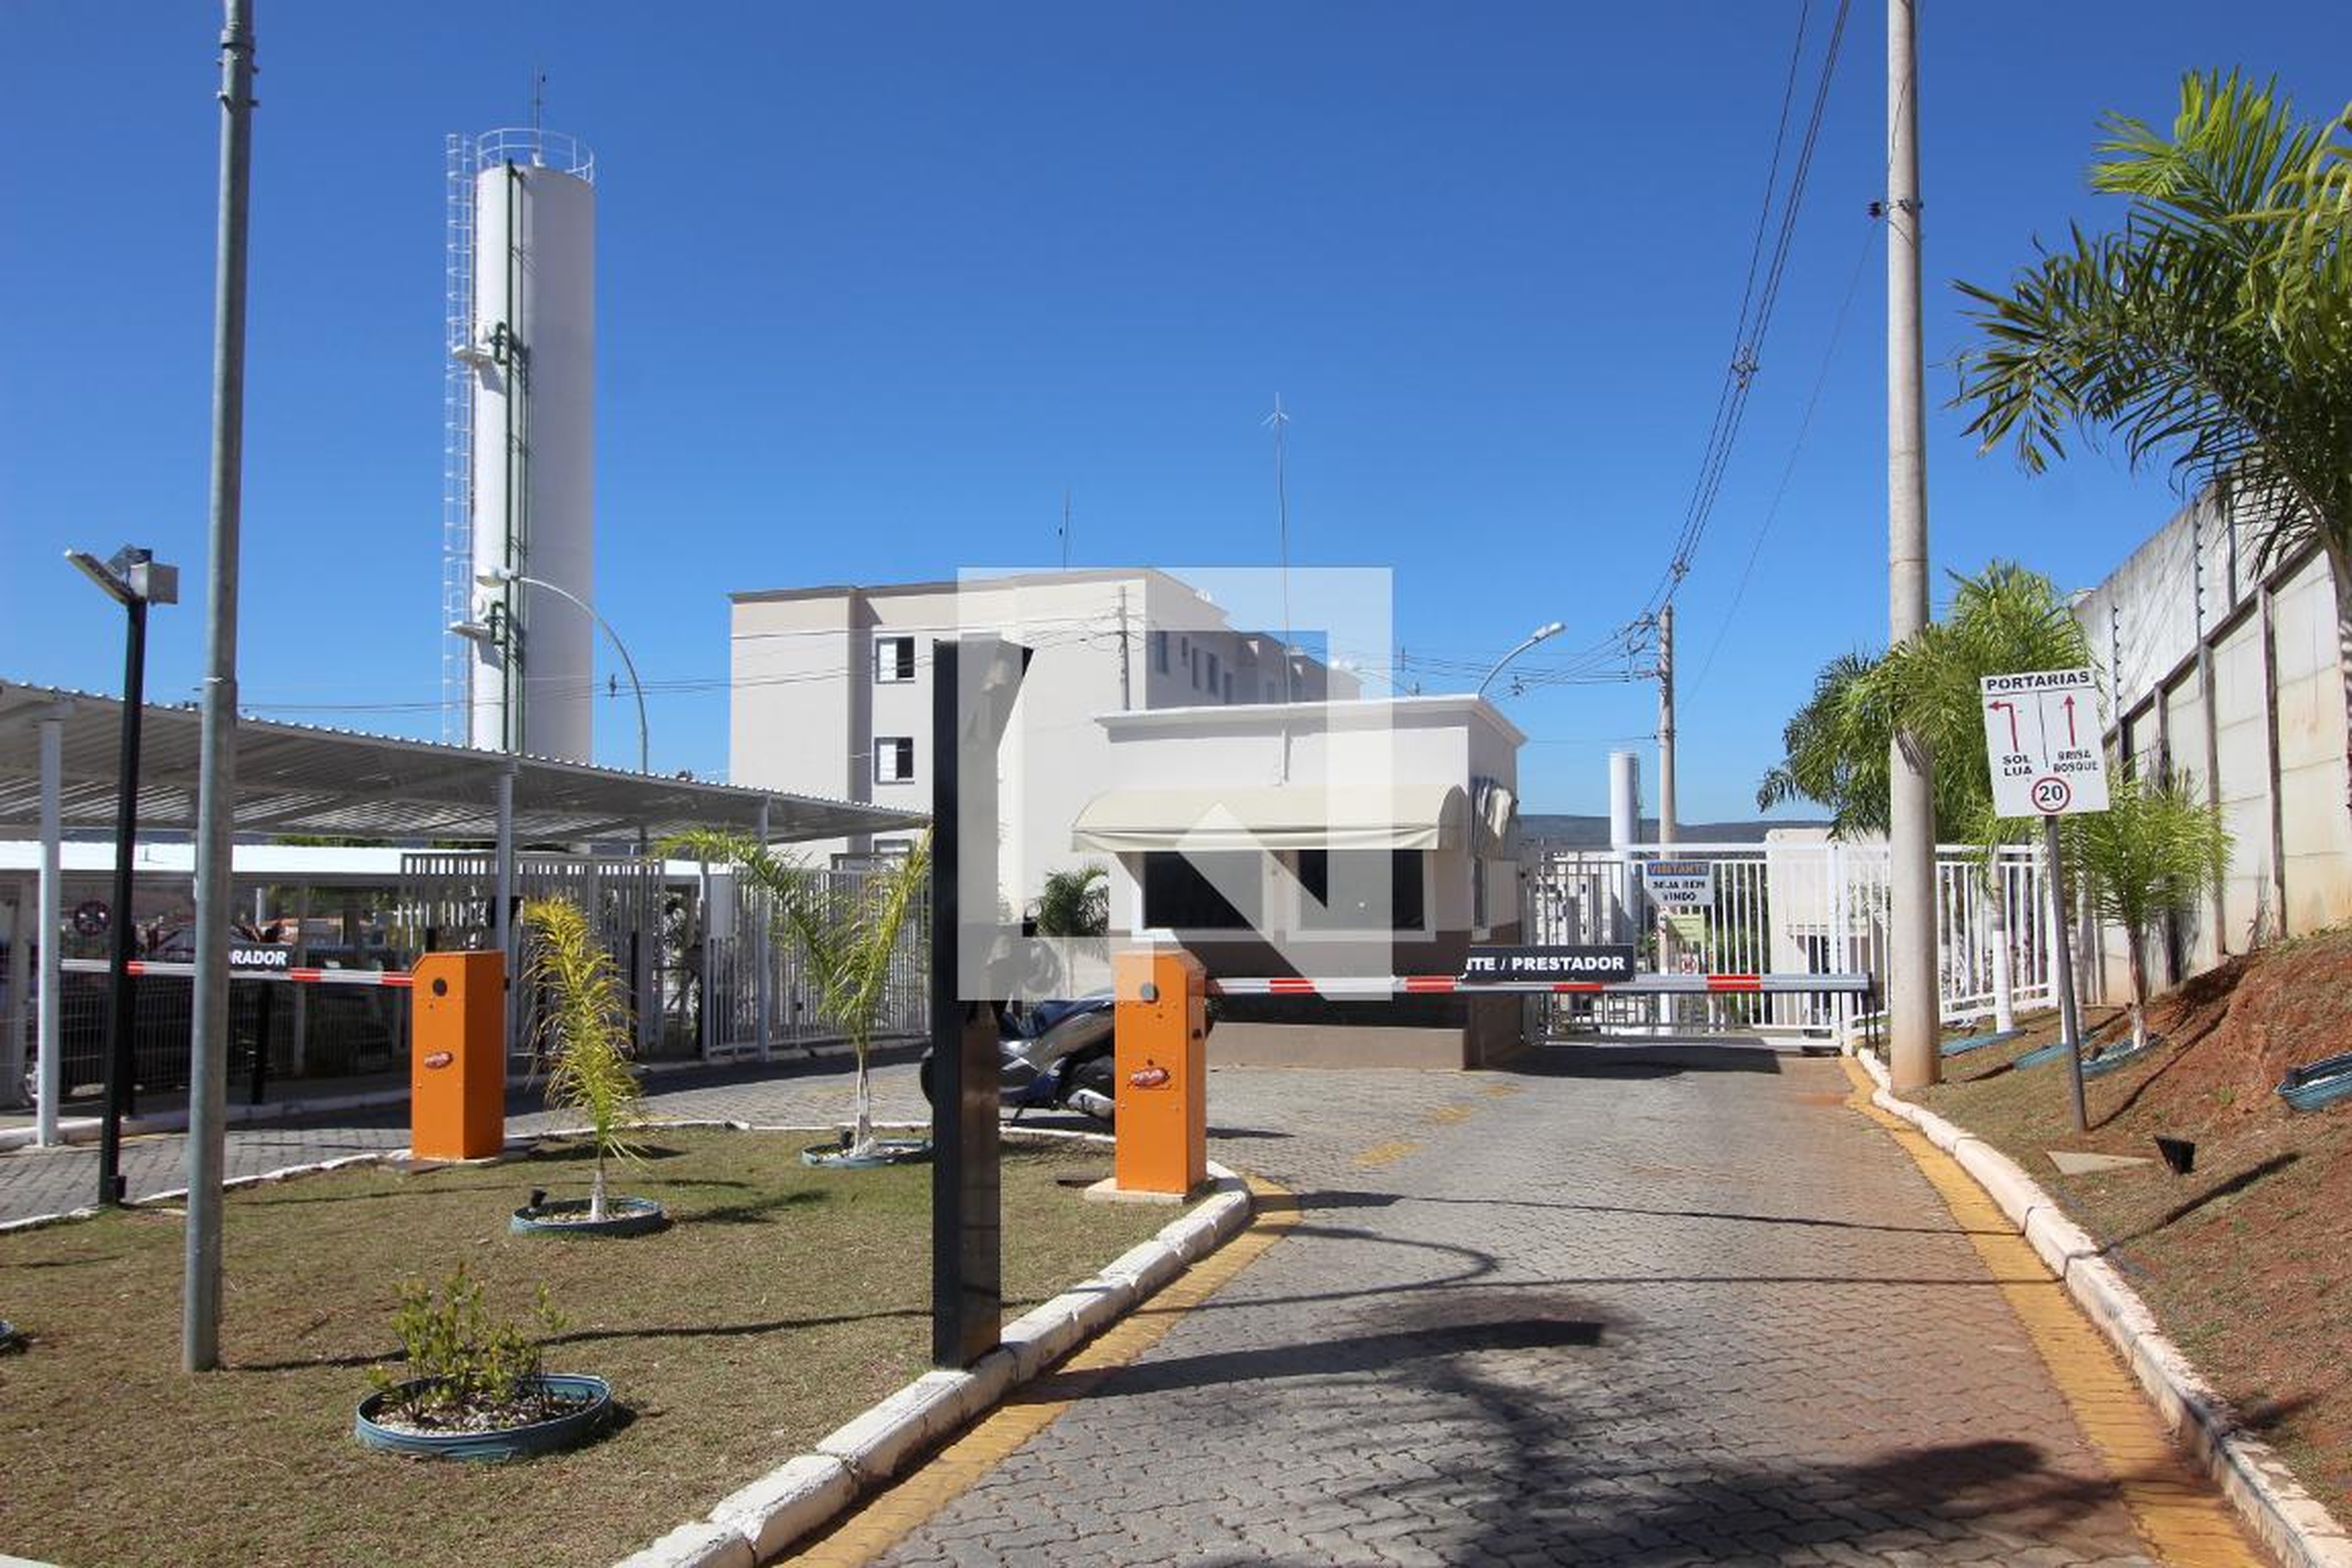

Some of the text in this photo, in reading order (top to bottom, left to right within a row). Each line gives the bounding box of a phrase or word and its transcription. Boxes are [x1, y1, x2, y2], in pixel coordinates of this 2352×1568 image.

[1986, 671, 2090, 691] PORTARIAS
[2002, 755, 2032, 765] SOL
[2004, 766, 2032, 777] LUA
[2053, 762, 2098, 774] BOSQUE
[2038, 785, 2063, 801] 20
[1653, 881, 1679, 889] SEJA
[228, 950, 287, 966] RADOR
[1512, 956, 1626, 971] PRESTADOR
